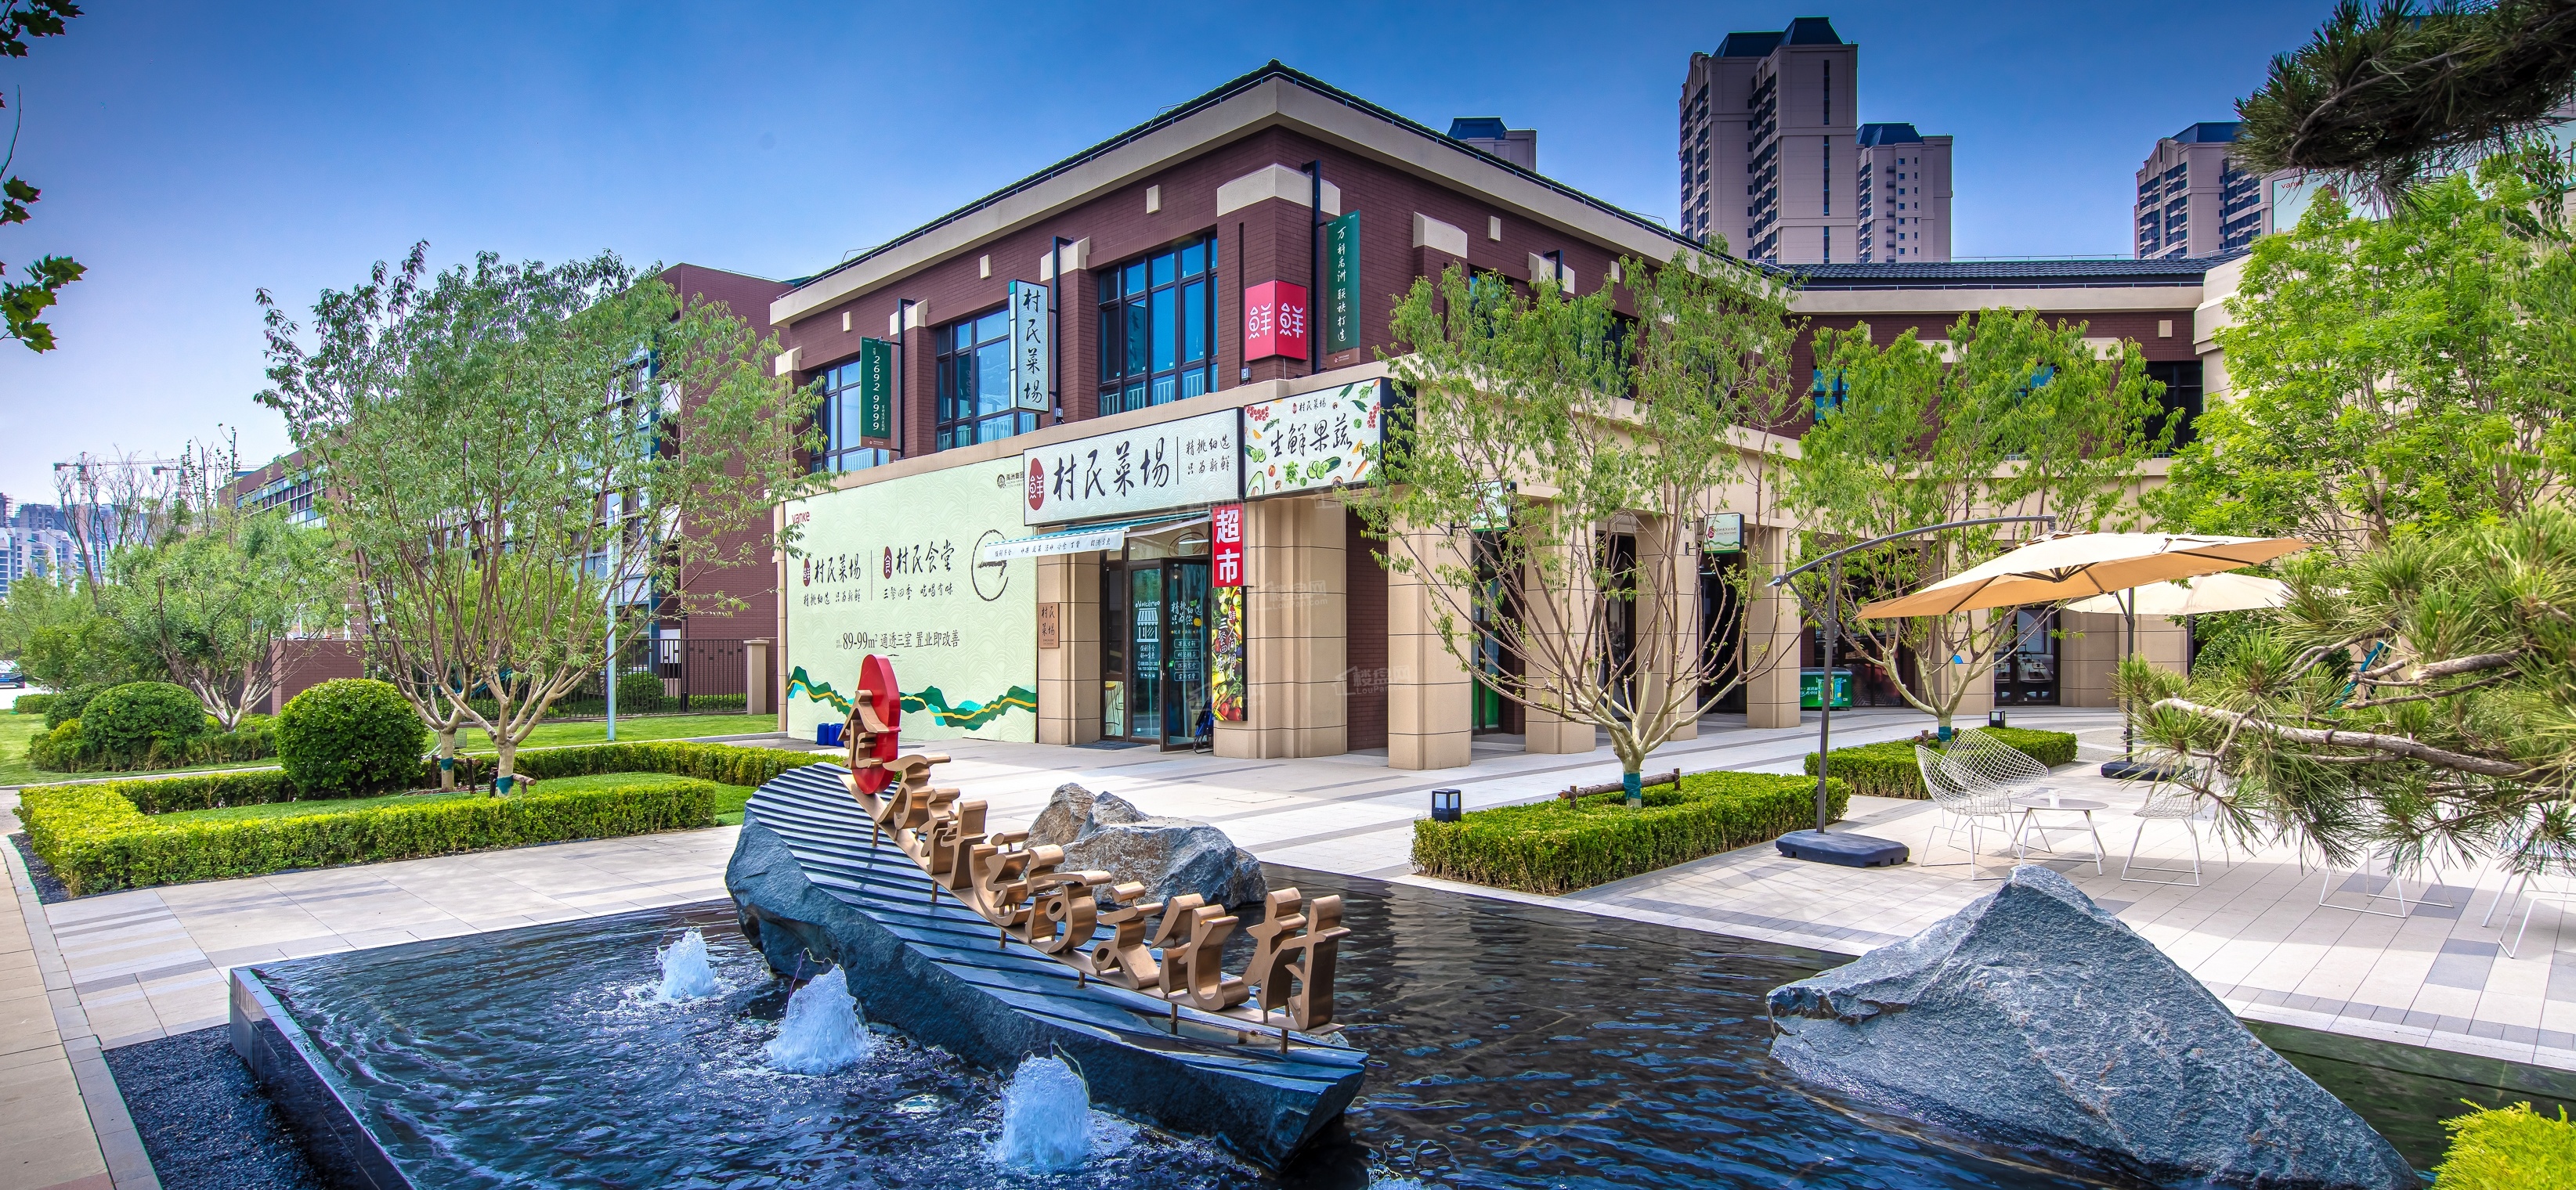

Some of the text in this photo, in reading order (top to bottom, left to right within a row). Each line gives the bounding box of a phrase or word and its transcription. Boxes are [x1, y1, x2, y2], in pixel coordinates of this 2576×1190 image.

[1337, 225, 1347, 342] 万科禹洲 联袂打造
[1186, 435, 1231, 456] 精挑细选
[1270, 413, 1353, 458] 生鲜果蔬
[896, 539, 956, 575] 村民食堂
[1216, 509, 1241, 584] 超市
[883, 582, 954, 601] 三餐四季 吃喝有味
[880, 632, 912, 649] 通透三室
[916, 629, 960, 648] 置业即改善
[1216, 617, 1228, 673] 三餐四季
[1227, 626, 1237, 681] 人间烟火
